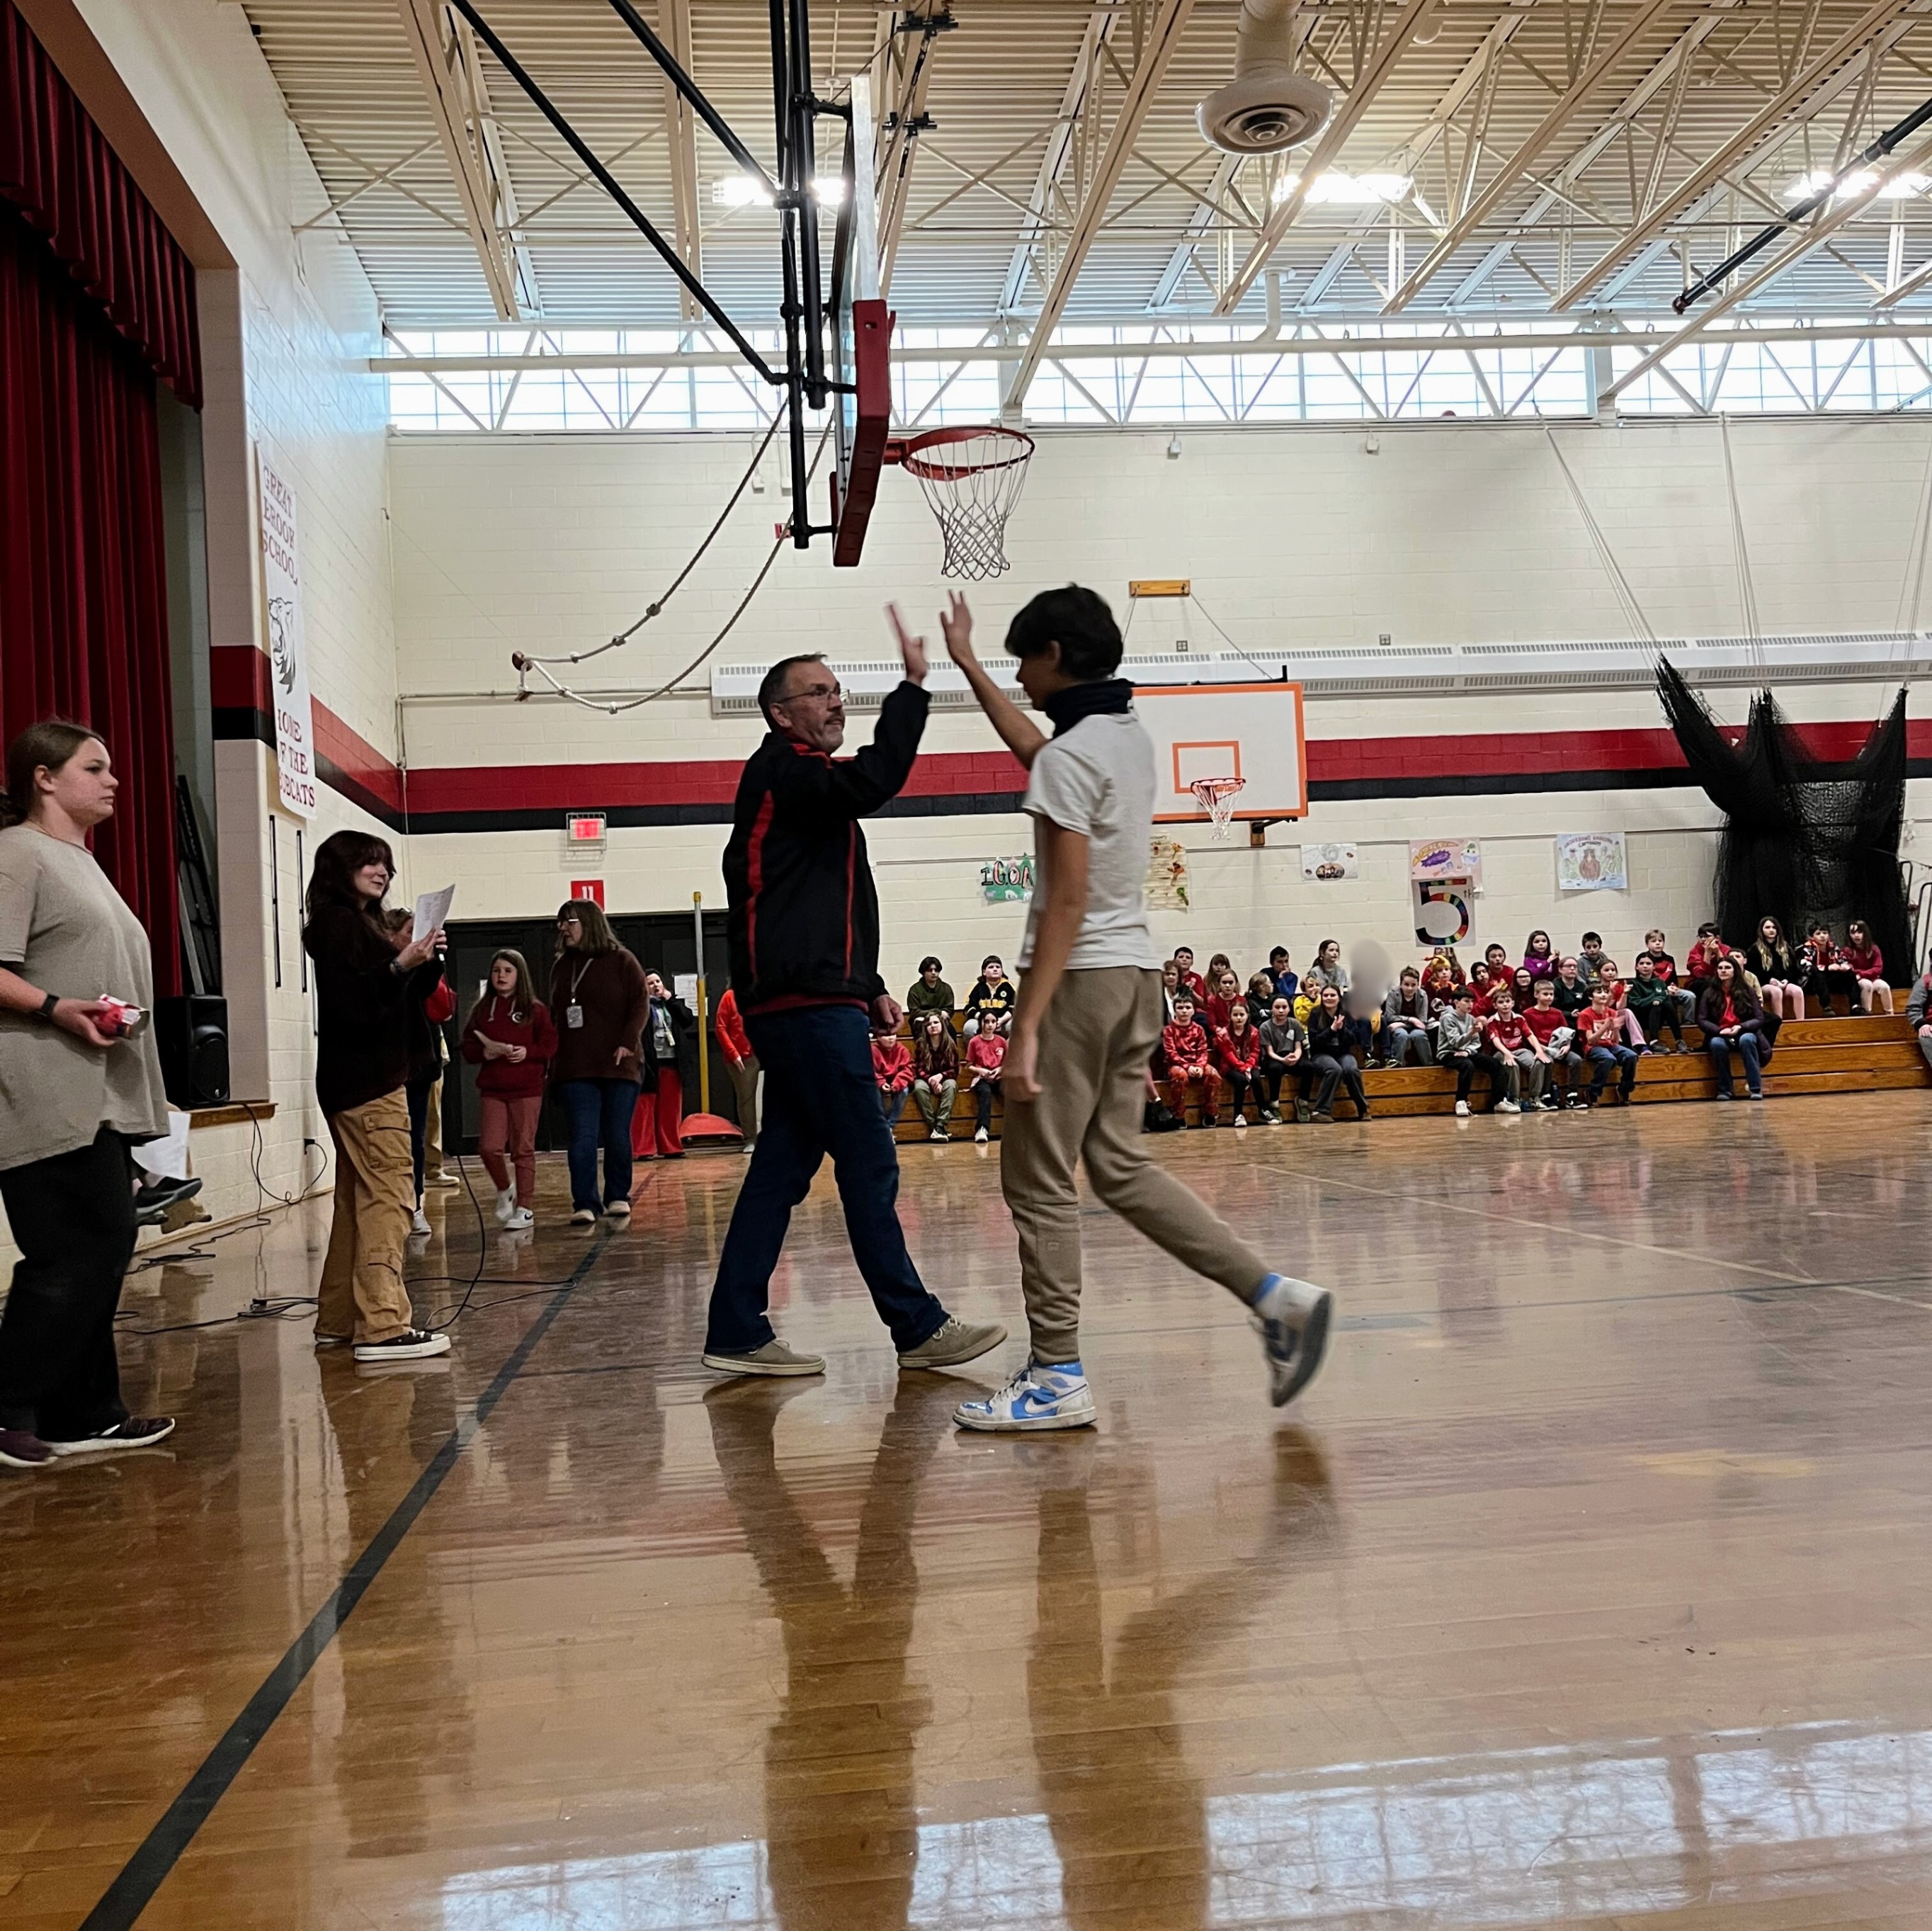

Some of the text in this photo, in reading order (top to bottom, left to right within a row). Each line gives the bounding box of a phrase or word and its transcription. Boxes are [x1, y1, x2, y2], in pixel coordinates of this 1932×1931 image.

[263, 465, 292, 519] GREAT
[279, 742, 307, 774] F THE
